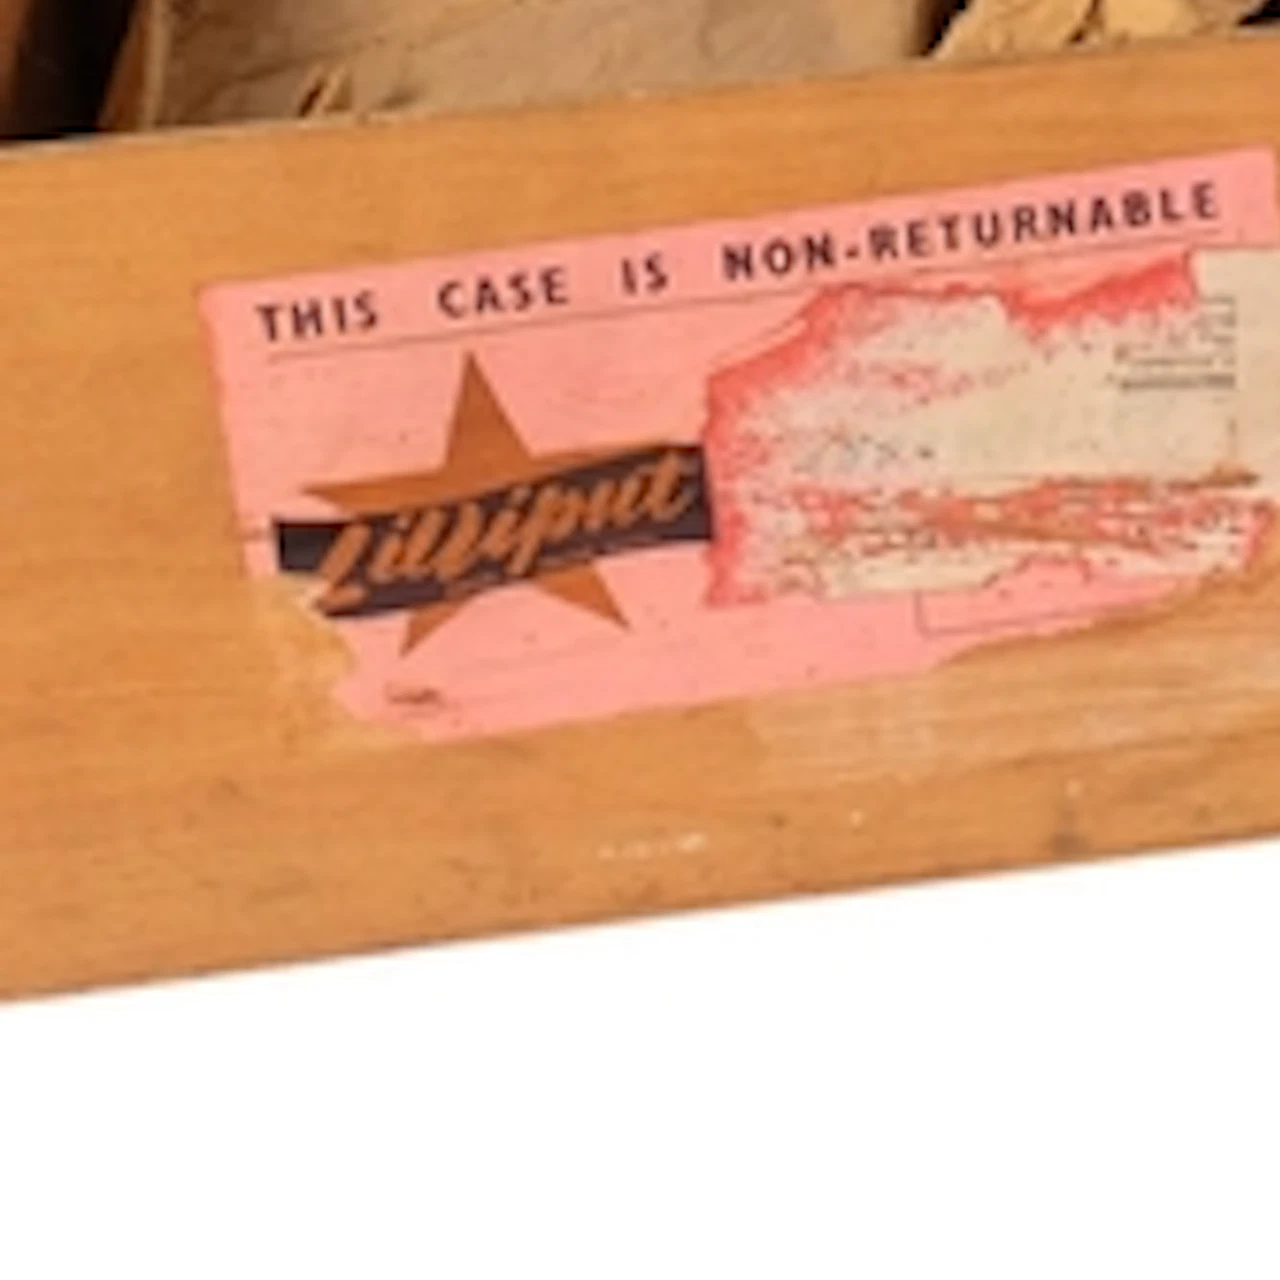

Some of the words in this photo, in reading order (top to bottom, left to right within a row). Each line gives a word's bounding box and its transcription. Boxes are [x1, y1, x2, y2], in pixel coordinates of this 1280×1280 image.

[256, 289, 380, 342] THIS
[437, 265, 570, 319] CASE
[620, 252, 671, 296] IS
[721, 180, 1219, 283] NON-RETURNABLE
[314, 449, 696, 612] Lilliput
